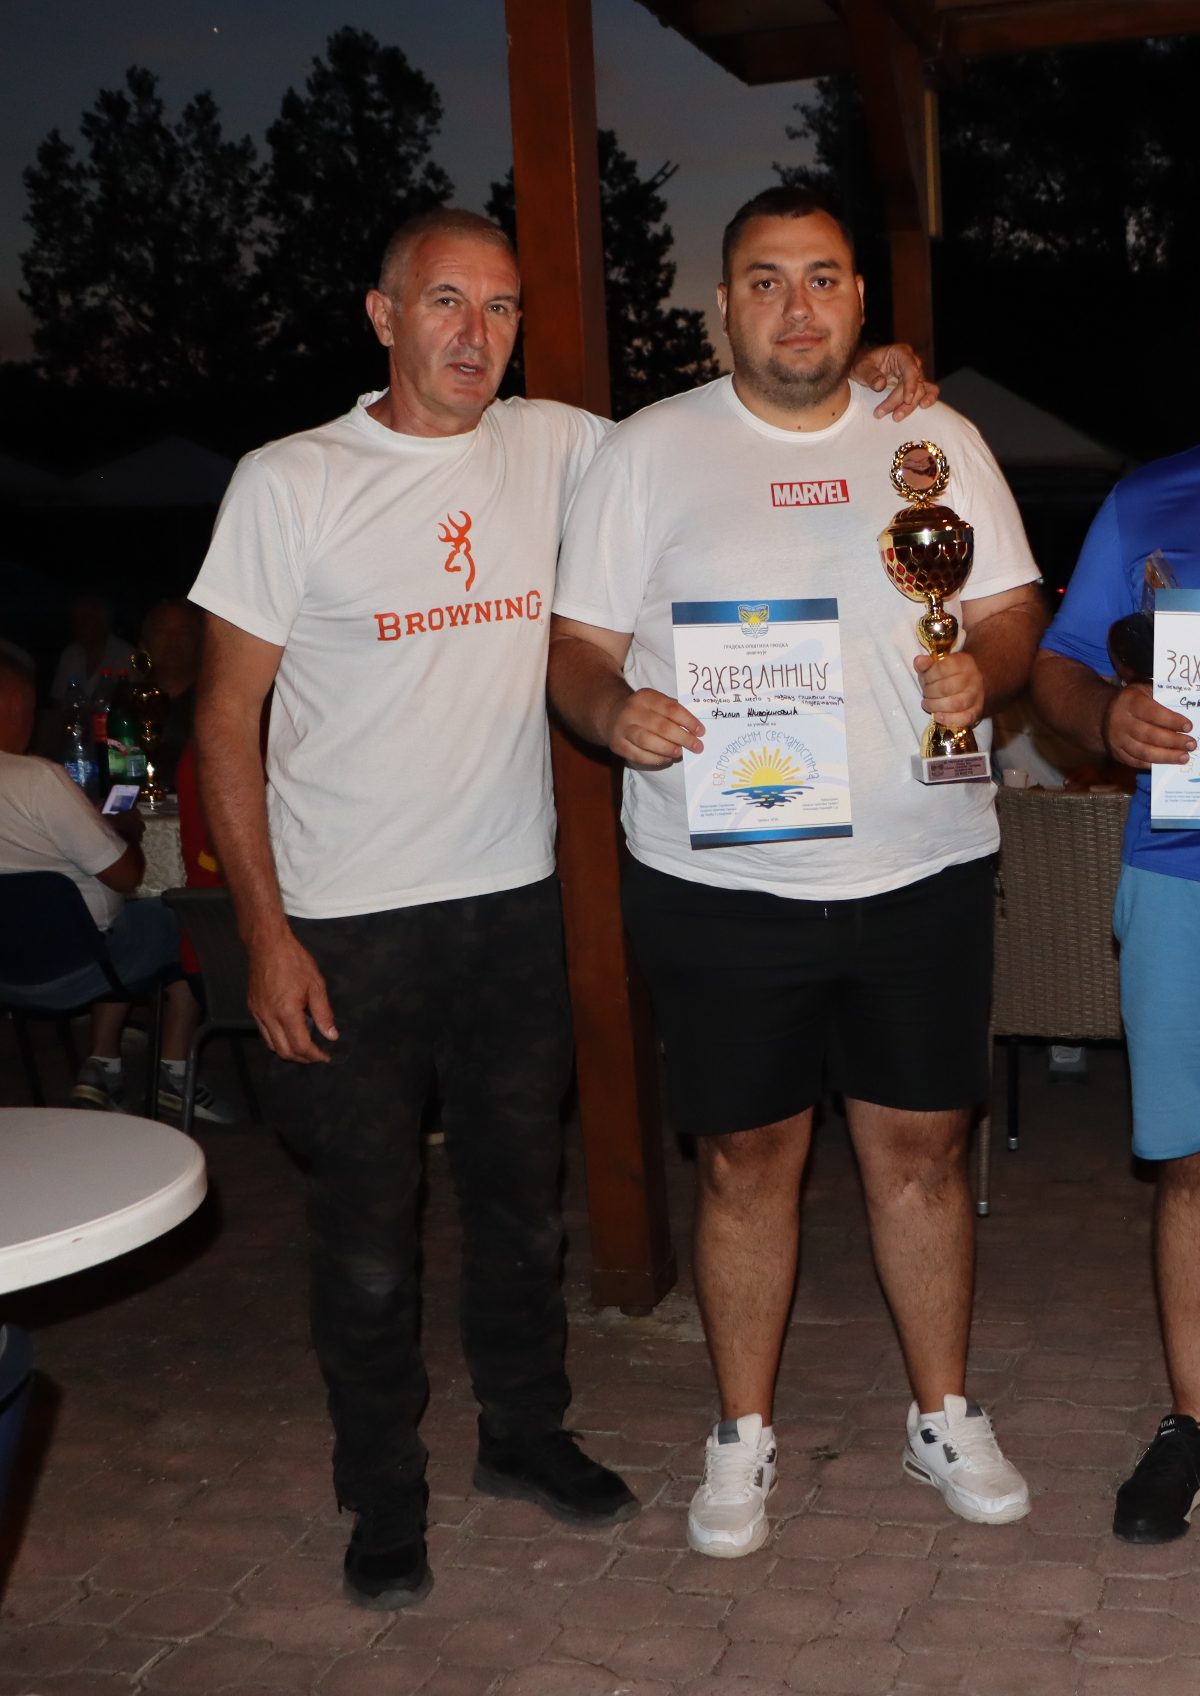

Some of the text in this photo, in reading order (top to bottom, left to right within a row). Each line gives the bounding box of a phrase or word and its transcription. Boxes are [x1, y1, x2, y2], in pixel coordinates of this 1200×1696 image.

[773, 481, 848, 506] MARVEL
[374, 590, 543, 641] BROWNING
[711, 707, 740, 720] Филип
